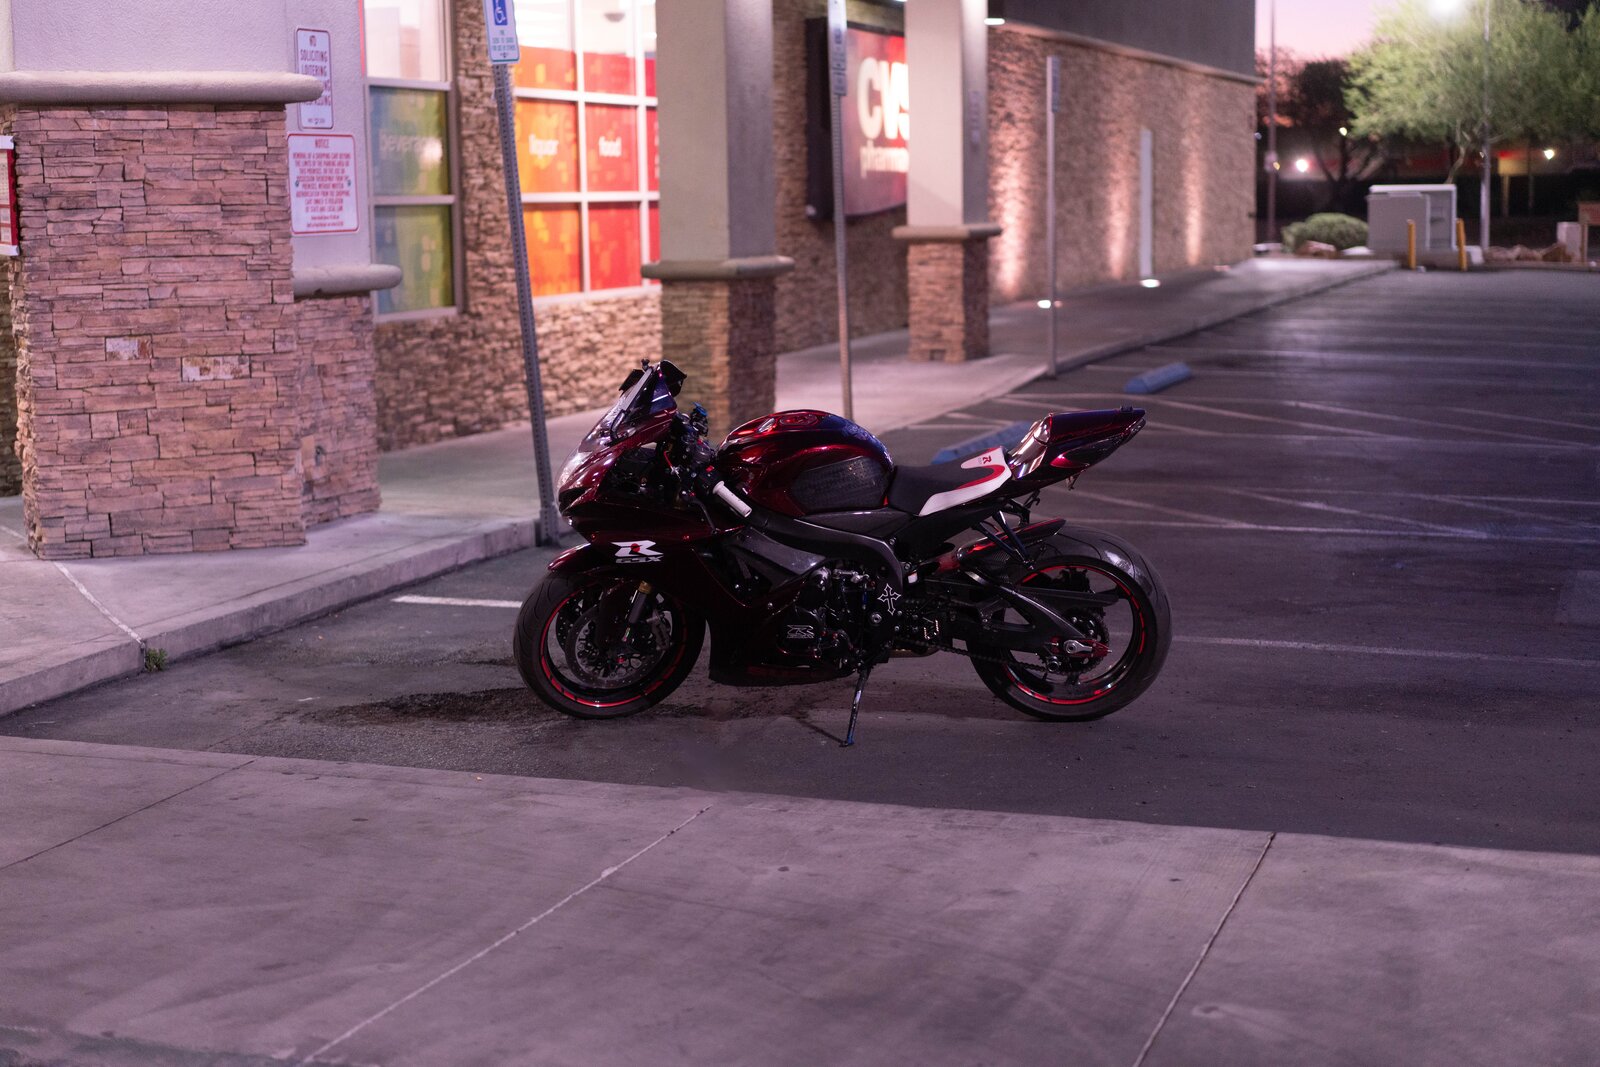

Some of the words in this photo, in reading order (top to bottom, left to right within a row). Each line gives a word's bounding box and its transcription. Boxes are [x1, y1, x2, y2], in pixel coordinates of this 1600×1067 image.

[300, 49, 328, 62] SOLICITING
[857, 57, 909, 140] CVS
[315, 138, 329, 149] NOTICE
[598, 135, 622, 157] food
